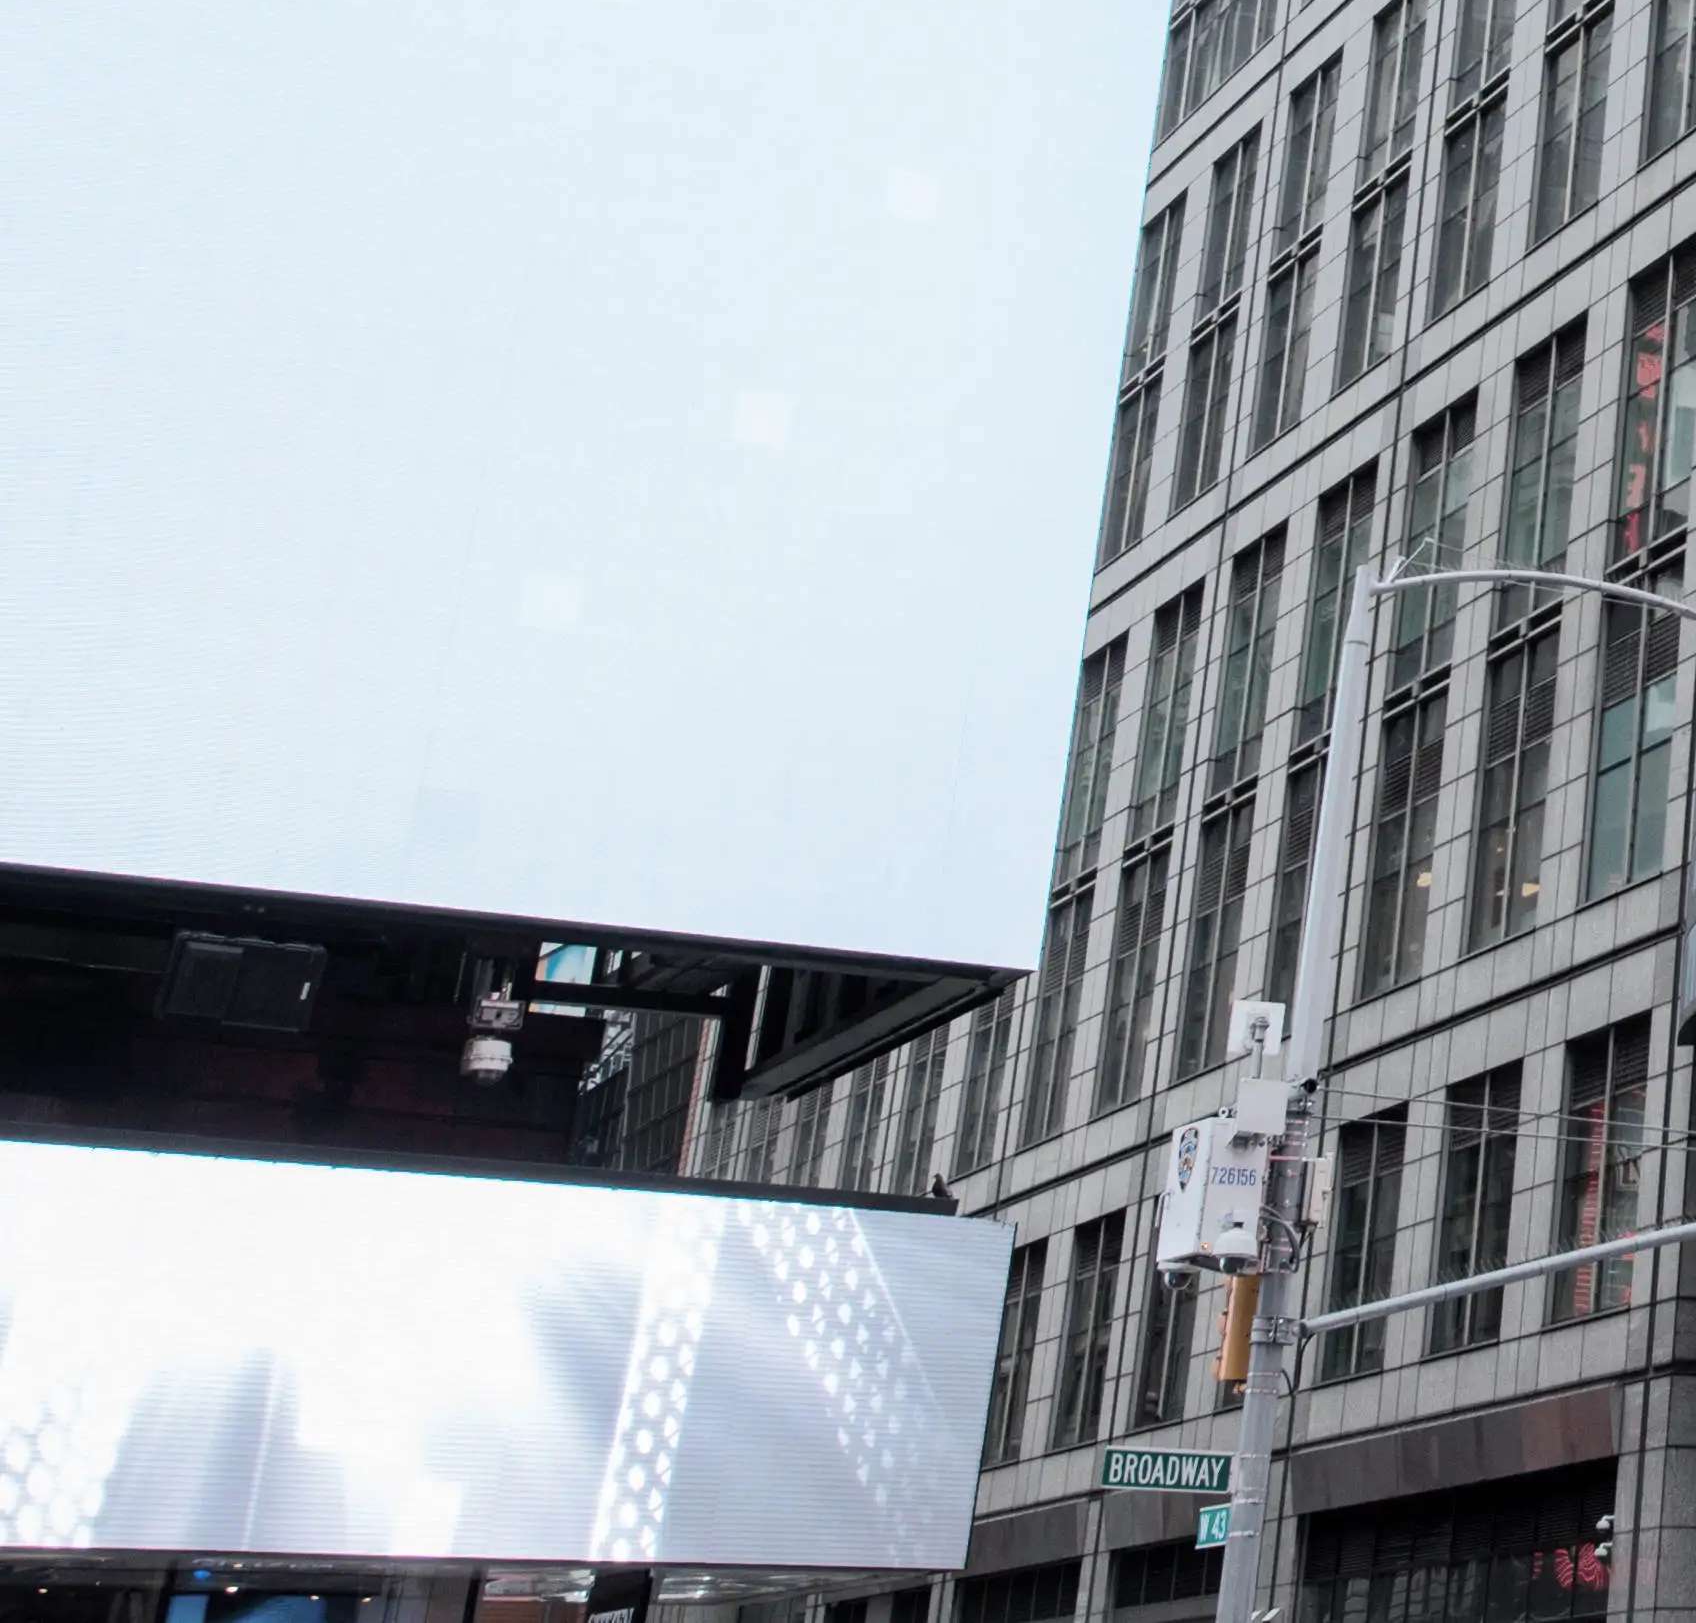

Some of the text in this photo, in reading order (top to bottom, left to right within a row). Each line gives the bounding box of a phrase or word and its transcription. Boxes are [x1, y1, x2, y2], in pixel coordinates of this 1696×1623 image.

[1211, 1166, 1257, 1186] 726156
[1109, 1452, 1225, 1488] BROADWAY
[1200, 1510, 1227, 1541] W 43
